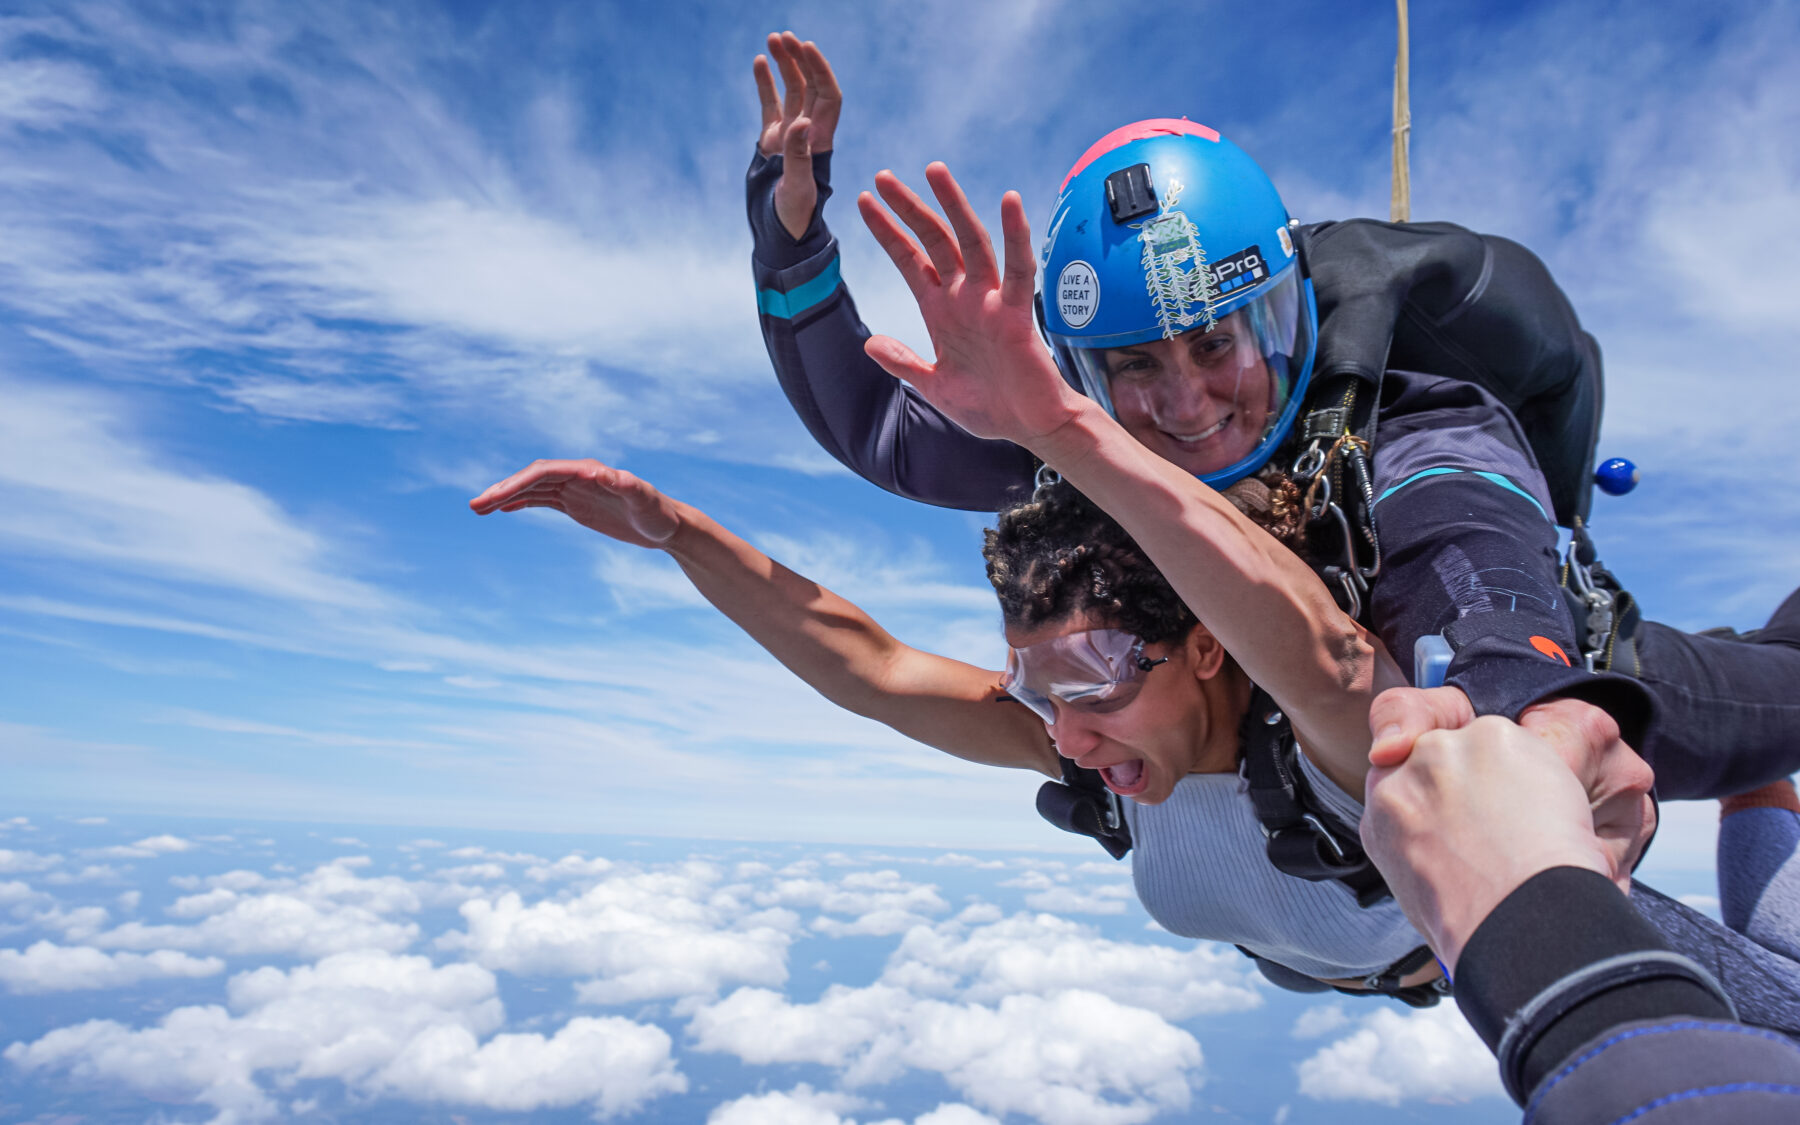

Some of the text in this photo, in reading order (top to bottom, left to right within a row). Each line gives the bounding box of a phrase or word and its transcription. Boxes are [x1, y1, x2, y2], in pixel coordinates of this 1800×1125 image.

[1063, 275, 1090, 285] LIVE A
[1062, 290, 1090, 300] GREAT
[1063, 305, 1089, 315] STORY
